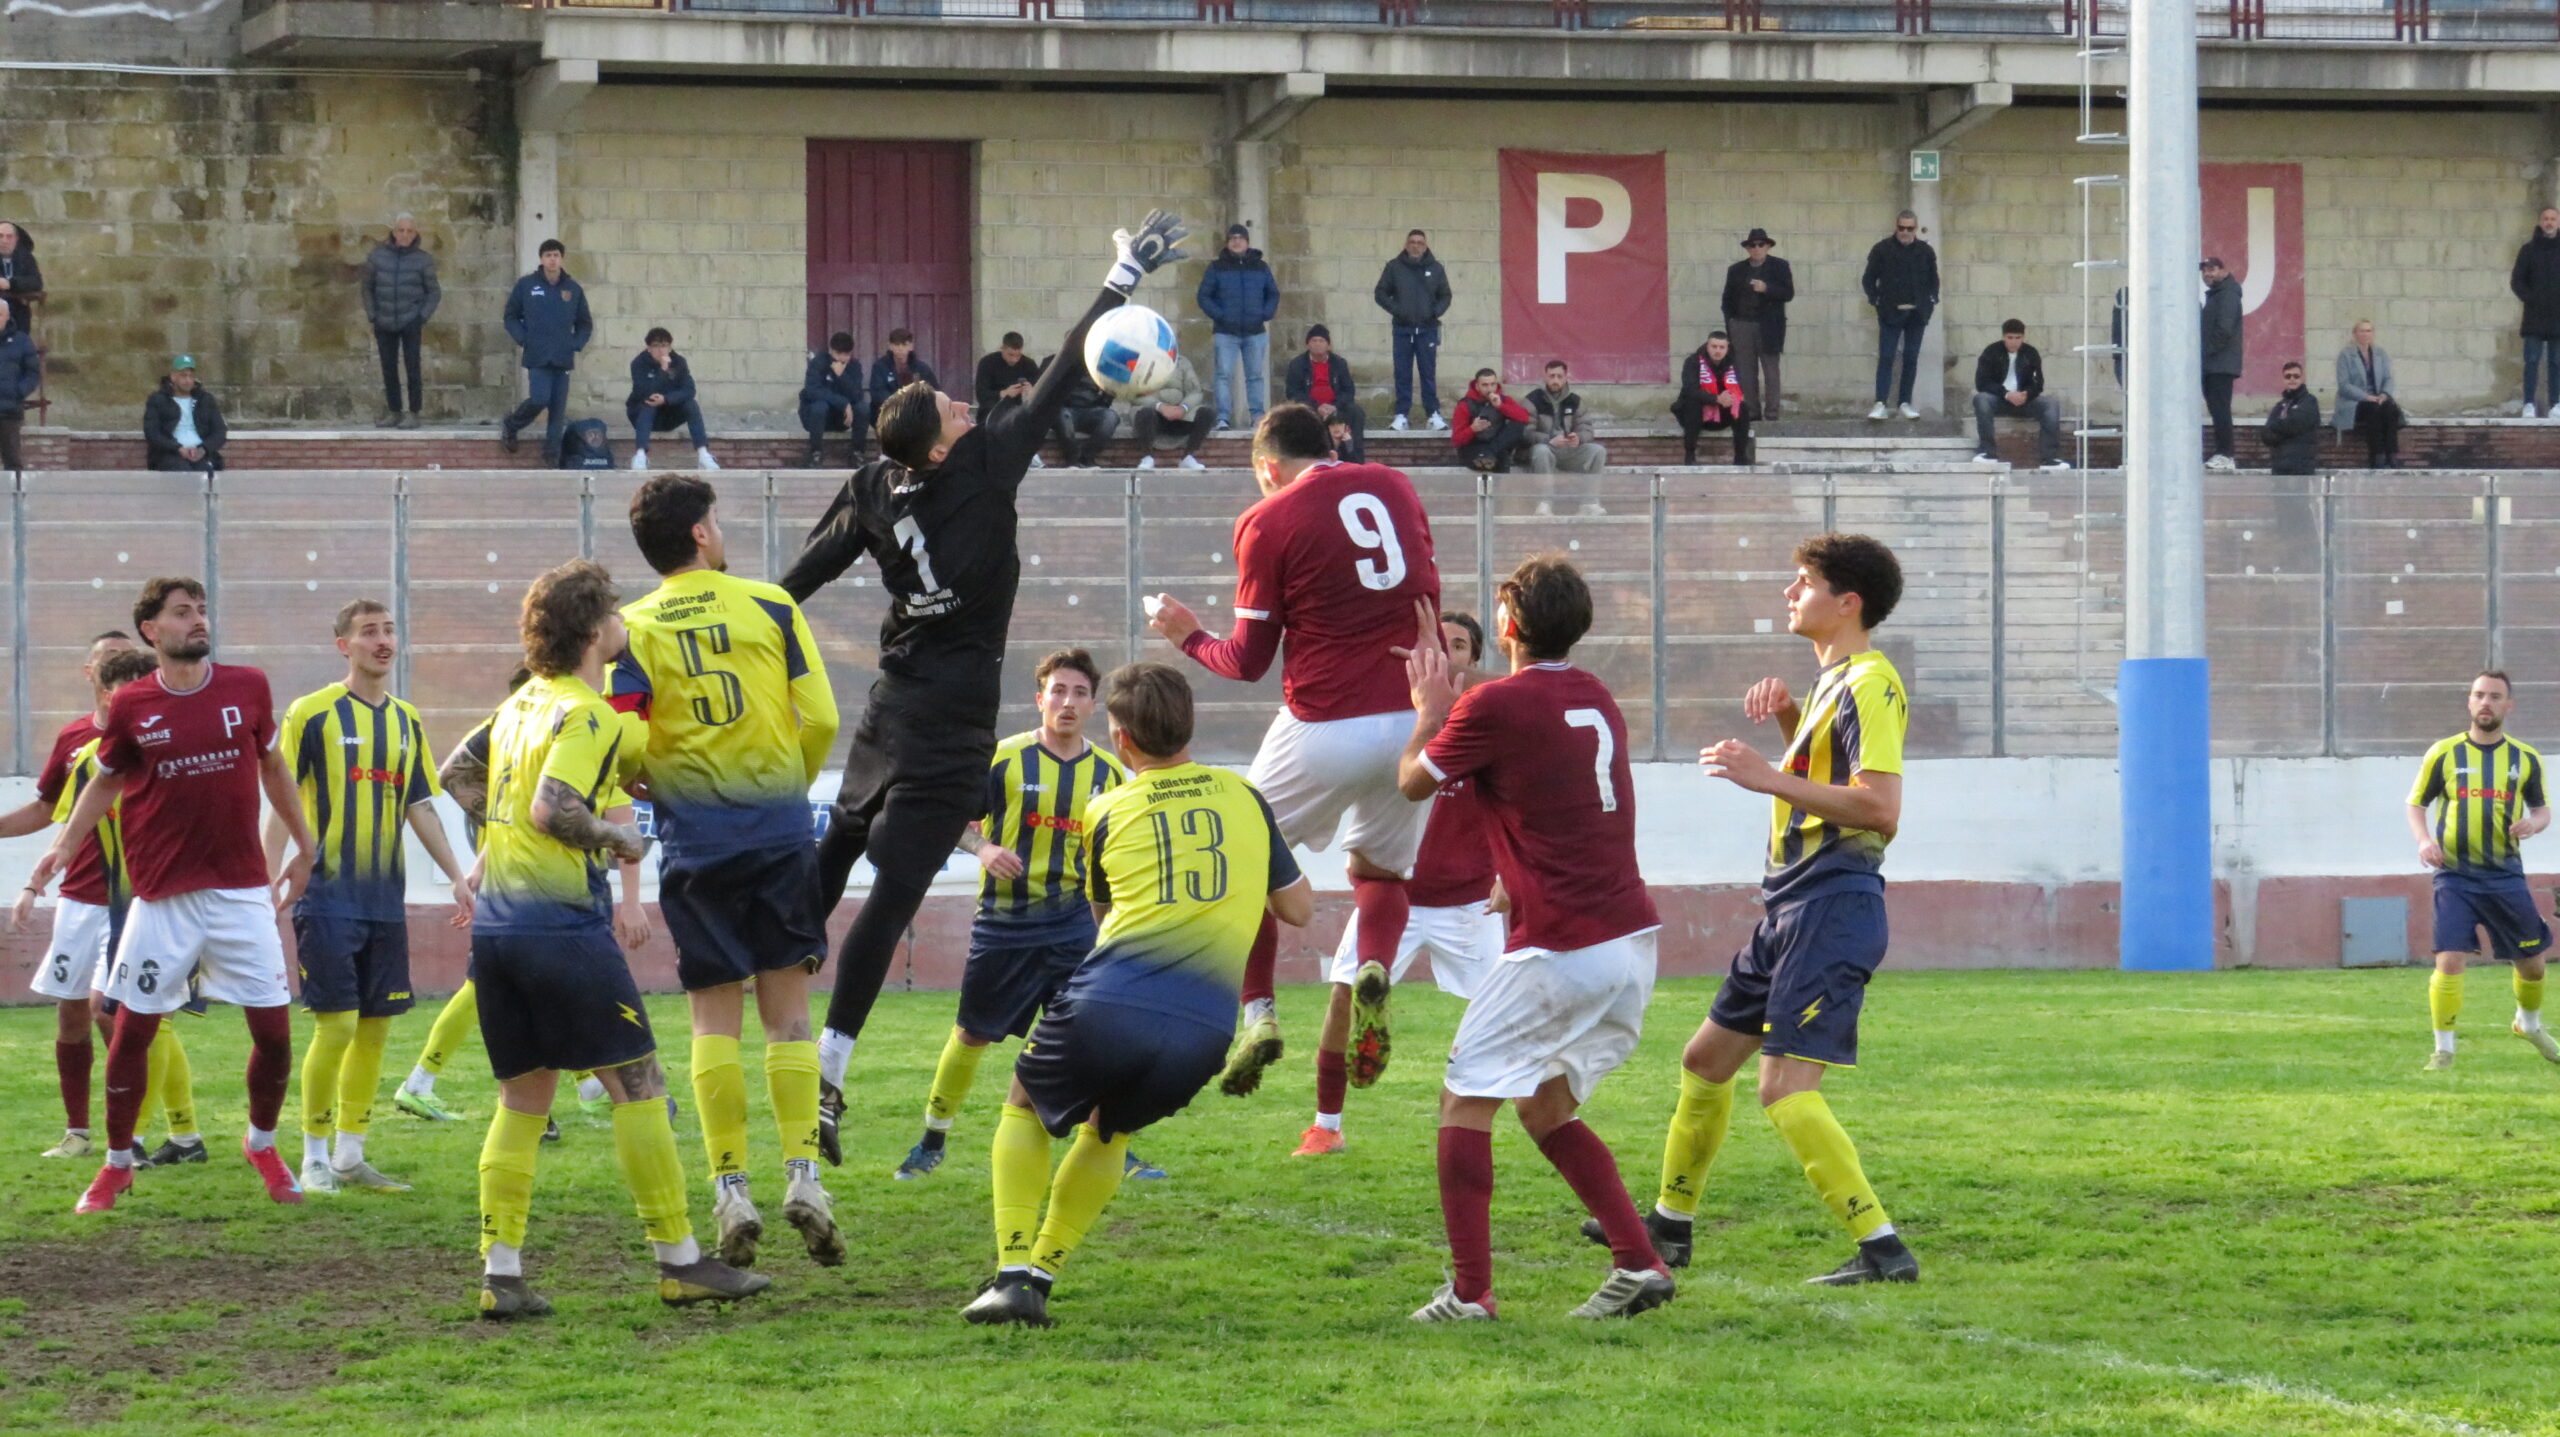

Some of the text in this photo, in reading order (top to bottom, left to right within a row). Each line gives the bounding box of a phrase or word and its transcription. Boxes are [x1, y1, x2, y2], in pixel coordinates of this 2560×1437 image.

[1537, 172, 1632, 304] P
[1338, 492, 1406, 590] 9
[655, 605, 706, 623] Minturno
[659, 590, 717, 610] Edilstrade
[676, 623, 744, 726] 5
[221, 705, 242, 739] P
[176, 748, 240, 767] CESARANO
[1564, 708, 1617, 812] 7
[1146, 788, 1202, 805] Minturno
[1152, 774, 1213, 790] Edilstrade
[1147, 808, 1227, 905] 13
